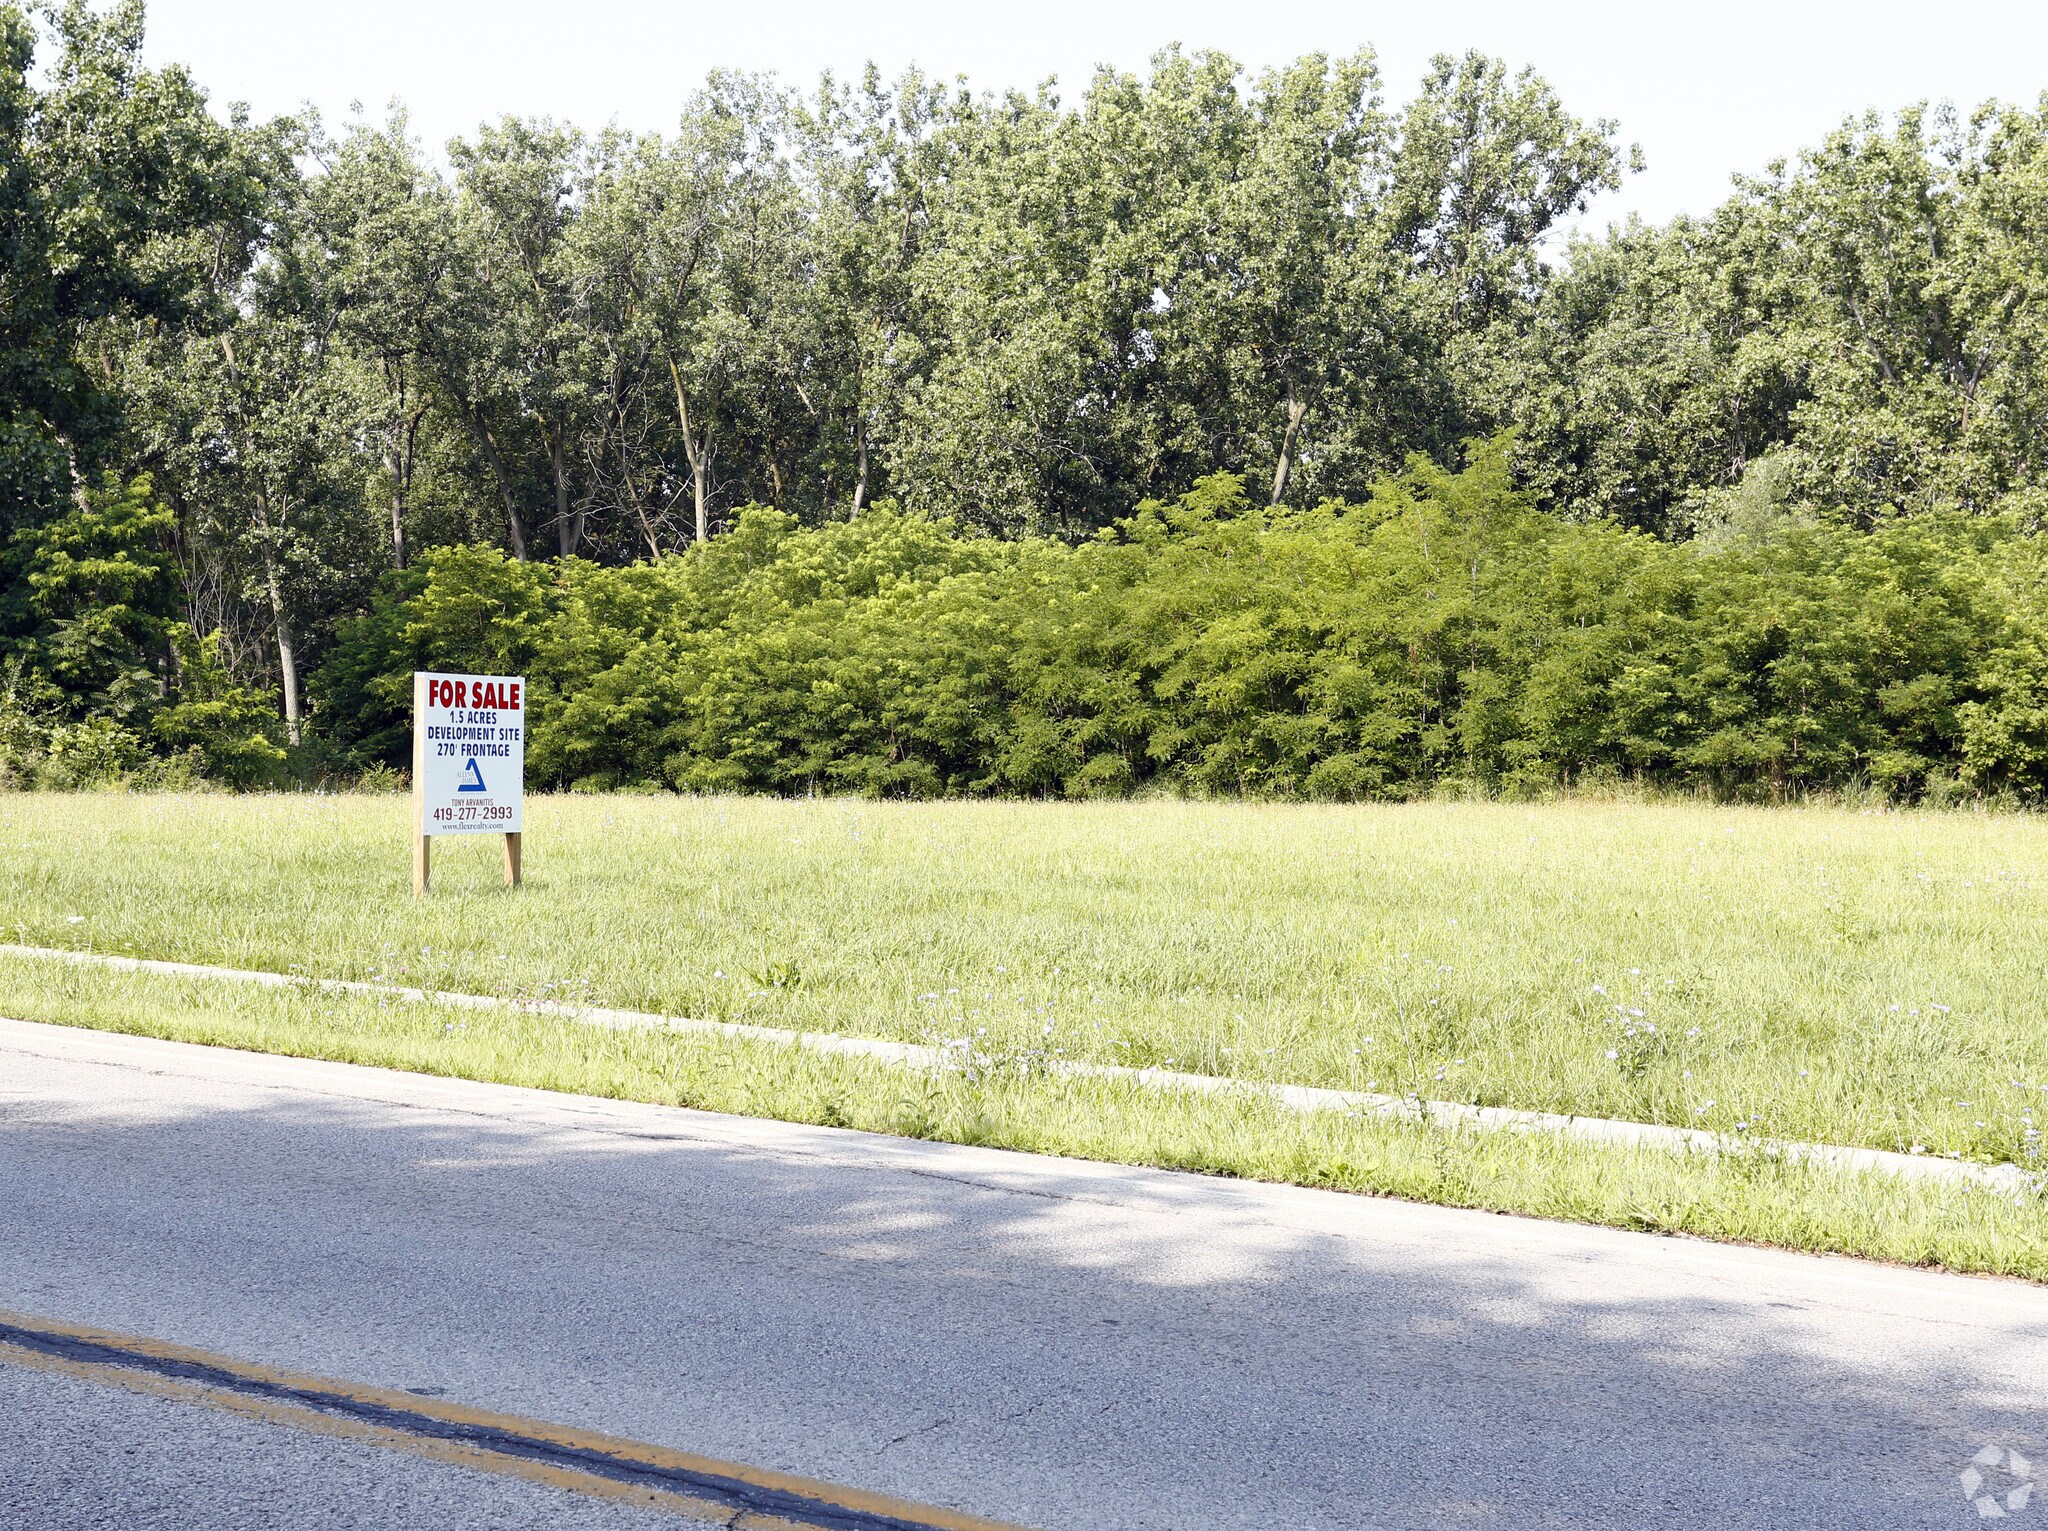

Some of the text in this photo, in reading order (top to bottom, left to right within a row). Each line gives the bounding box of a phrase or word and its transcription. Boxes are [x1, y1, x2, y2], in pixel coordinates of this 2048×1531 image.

[429, 680, 520, 710] FOR SALE
[449, 710, 497, 725] 1.5 ACRES
[428, 726, 520, 741] DEVELOPMENT SITE
[437, 743, 510, 757] 270' FRONTAGE
[451, 798, 494, 807] TONY ARVANITIS
[433, 806, 513, 821] 419-277-2993
[442, 821, 504, 830] www.flexrealty.com
